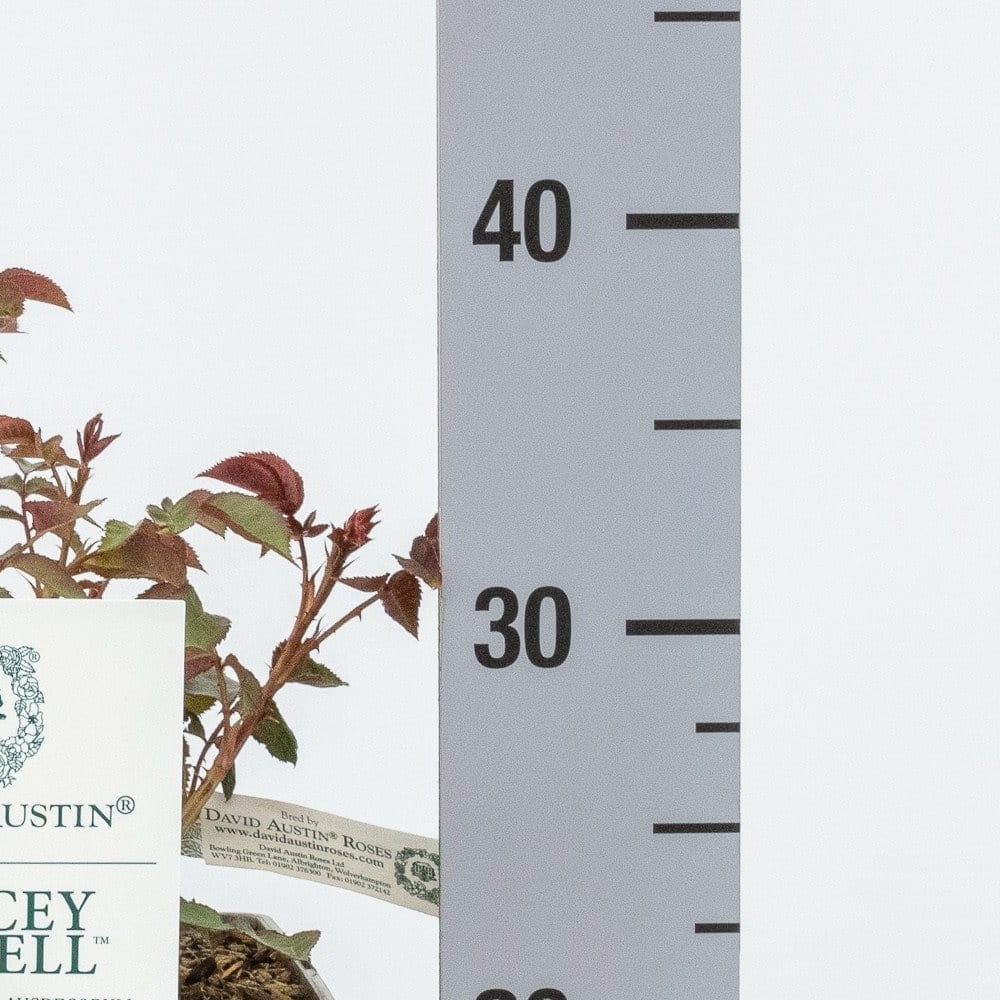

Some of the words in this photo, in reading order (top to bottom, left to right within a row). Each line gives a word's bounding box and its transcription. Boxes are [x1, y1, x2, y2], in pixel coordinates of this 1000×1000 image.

[472, 178, 572, 263] 40
[473, 586, 572, 669] 30
[205, 808, 261, 828] DAVID
[341, 835, 392, 859] ROSES
[281, 810, 304, 823] Bred
[307, 815, 318, 827] by
[209, 844, 241, 856] Bowling
[242, 848, 266, 858] Green
[335, 867, 392, 889] Wolverhampton
[214, 826, 384, 868] www.davidaustinroses.com
[259, 844, 282, 854] David
[284, 849, 308, 859] Austin
[309, 853, 331, 864] Roses
[211, 852, 232, 861] WV7
[272, 861, 294, 871] 01902
[344, 876, 366, 888] 01902
